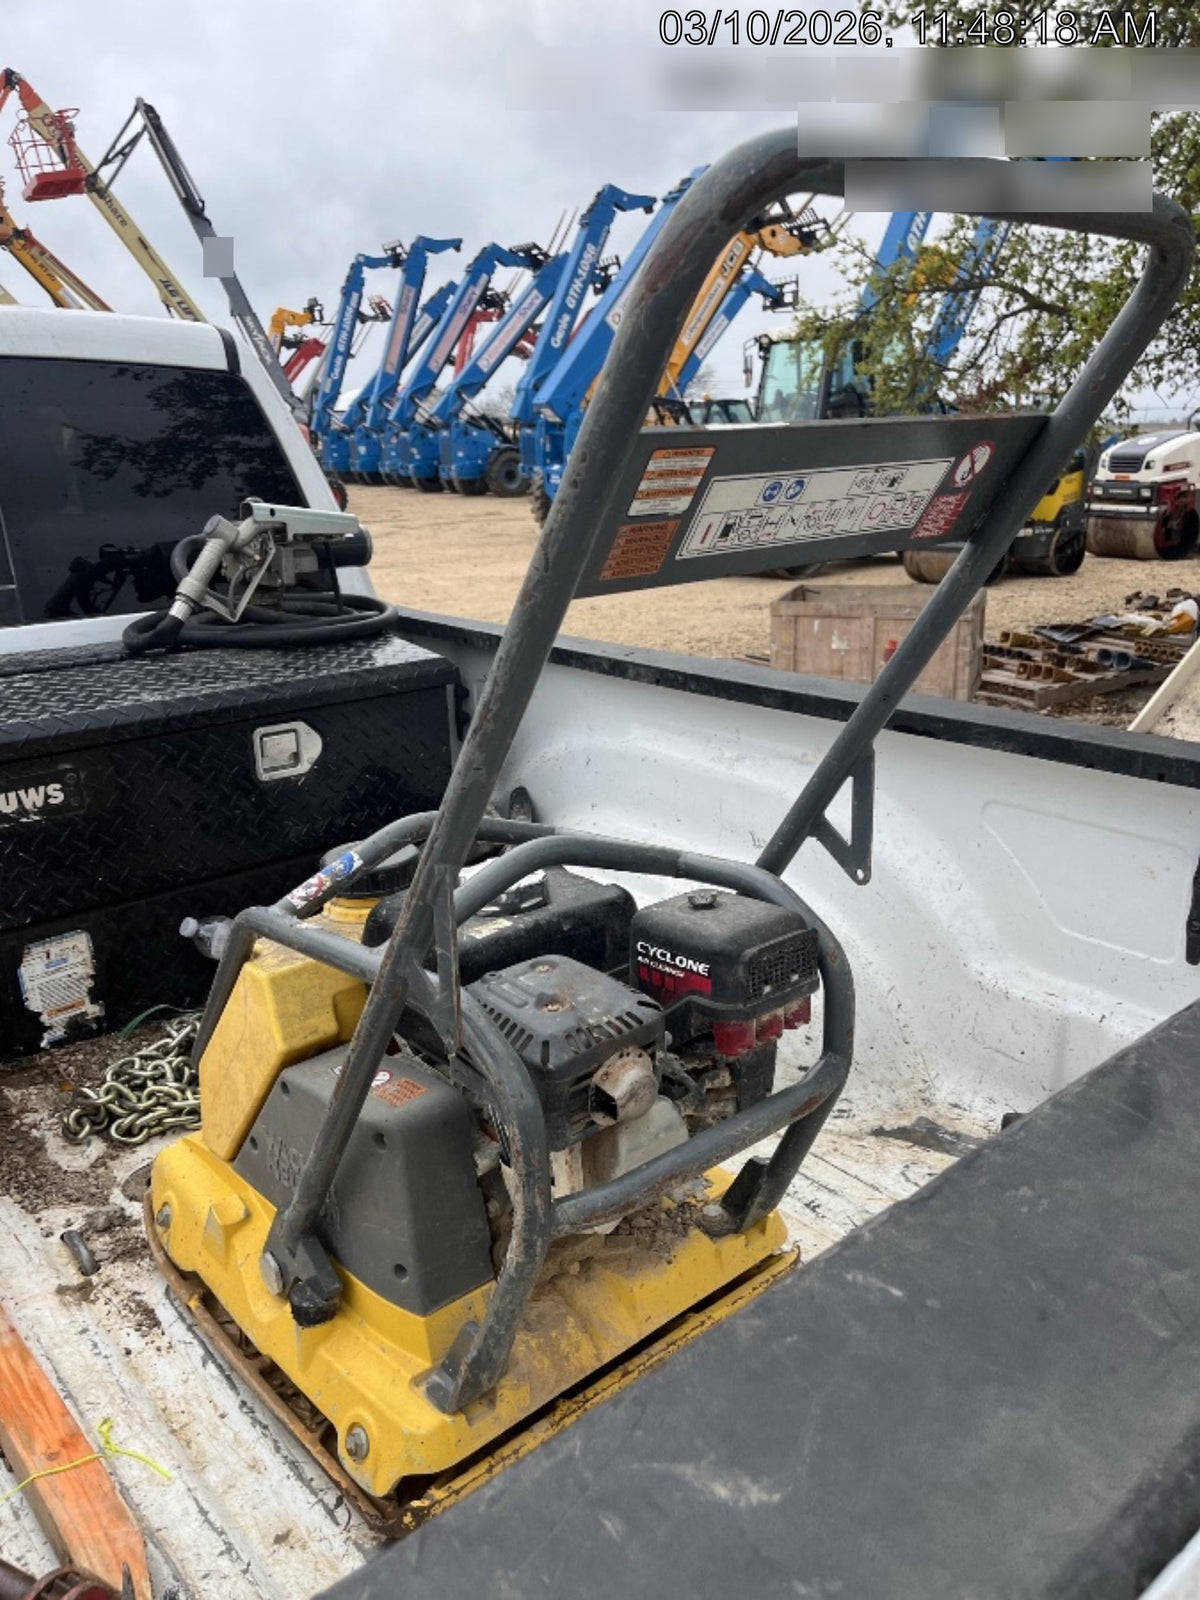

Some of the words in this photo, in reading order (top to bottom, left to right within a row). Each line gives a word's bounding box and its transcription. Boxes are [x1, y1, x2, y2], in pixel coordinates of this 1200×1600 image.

[721, 241, 744, 277] JCB
[159, 278, 179, 299] JLG
[550, 313, 571, 348] Genie
[0, 783, 65, 813] UWS
[636, 941, 710, 977] CYCLONE
